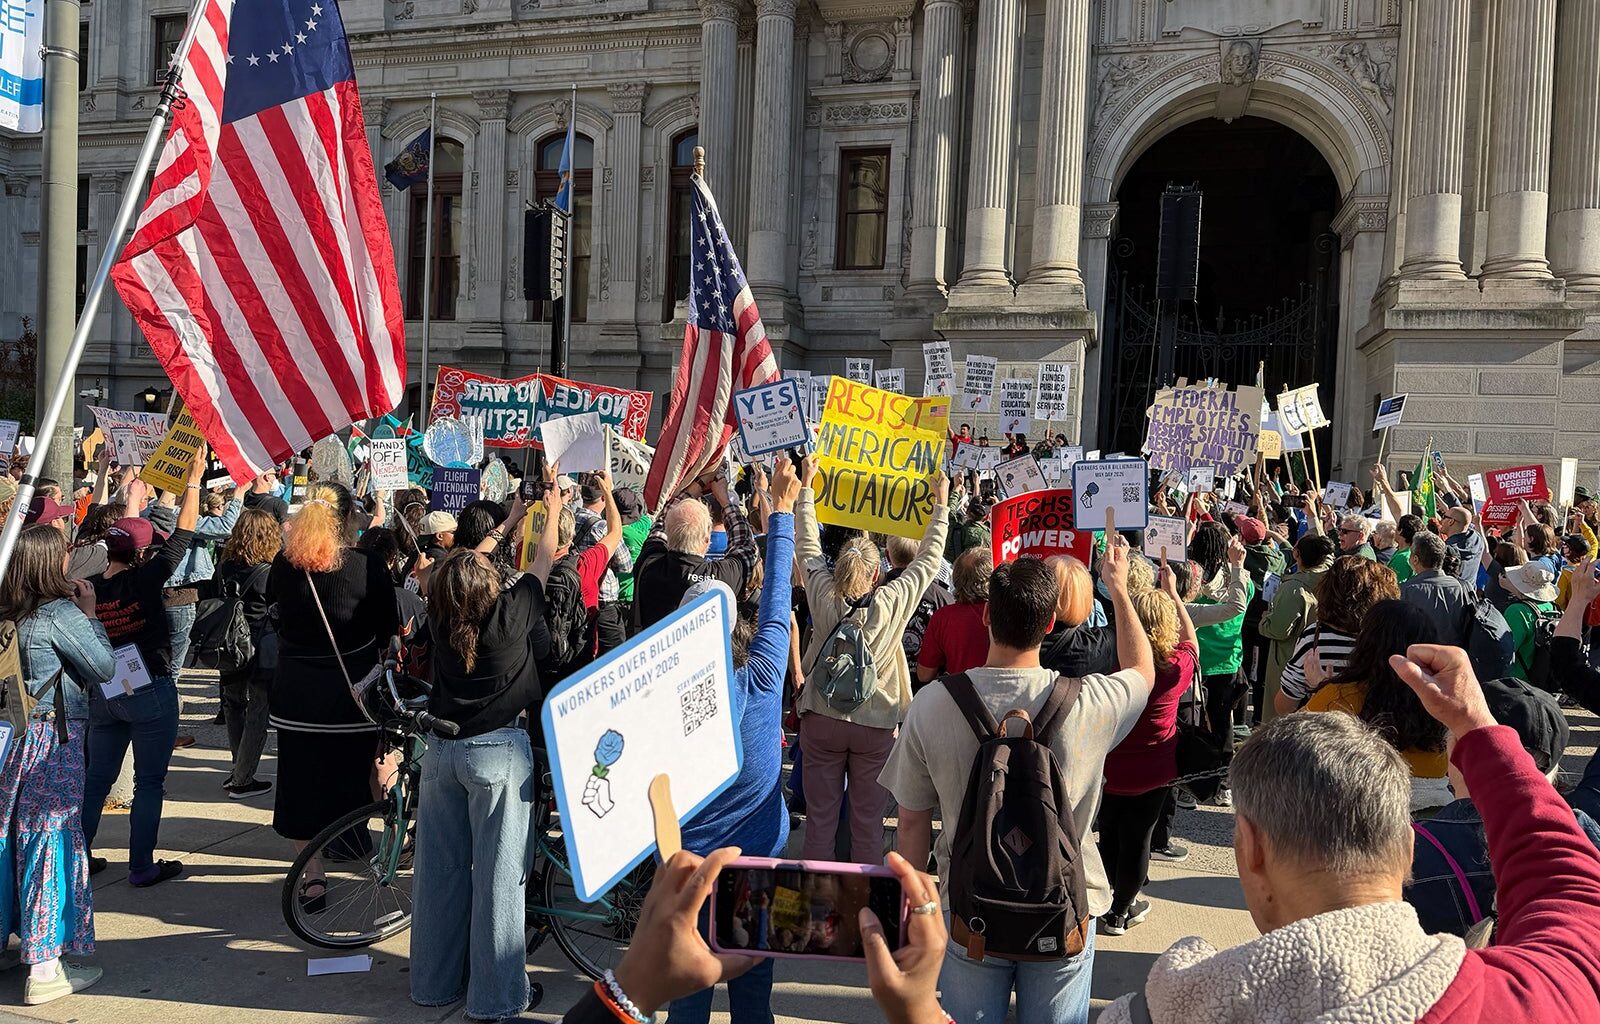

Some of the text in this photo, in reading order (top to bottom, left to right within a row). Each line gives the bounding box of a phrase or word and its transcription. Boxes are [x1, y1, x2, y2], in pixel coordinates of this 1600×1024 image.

[1046, 364, 1064, 372] FULLY
[1042, 374, 1065, 382] FUNDED
[964, 388, 992, 396] COMMUNITIES
[1006, 382, 1032, 390] THRIVING
[1040, 382, 1060, 391] PUBLIC
[740, 386, 793, 415] YES
[1040, 392, 1062, 401] HUMAN
[1173, 390, 1240, 412] FEDERAL
[827, 378, 931, 430] RESIST
[1000, 400, 1030, 408] EDUCATION
[1036, 402, 1064, 410] SERVICES
[138, 414, 148, 426] AT
[1152, 404, 1250, 432] EMPLOYEES
[1150, 422, 1194, 440] DESERVE
[372, 441, 405, 450] HANDS
[816, 422, 943, 474] AMERICAN
[1148, 436, 1244, 464] RESPECT AND TO
[165, 446, 194, 464] SAFETY
[373, 451, 402, 462] OFF
[153, 460, 186, 480] AT RISK
[1152, 452, 1164, 468] BE
[1166, 454, 1192, 473] PAID
[1211, 460, 1238, 476] TIME
[444, 470, 469, 483] FLIGHT
[1495, 468, 1537, 482] WORKERS
[434, 482, 478, 494] ATTENDANTS
[1499, 477, 1537, 489] DESERVE
[813, 466, 937, 526] DICTATORS
[1506, 486, 1533, 496] MORE!
[443, 494, 468, 508] SAVE
[1007, 496, 1072, 521] TECHS
[1003, 513, 1074, 540] & PROS
[1002, 530, 1075, 560] POWER
[688, 573, 716, 582] resist
[558, 605, 717, 718] WORKERS OVER BILLIONAIRES
[610, 652, 680, 710] MAY DAY 2026
[676, 660, 717, 694] STAY INVOLVED
